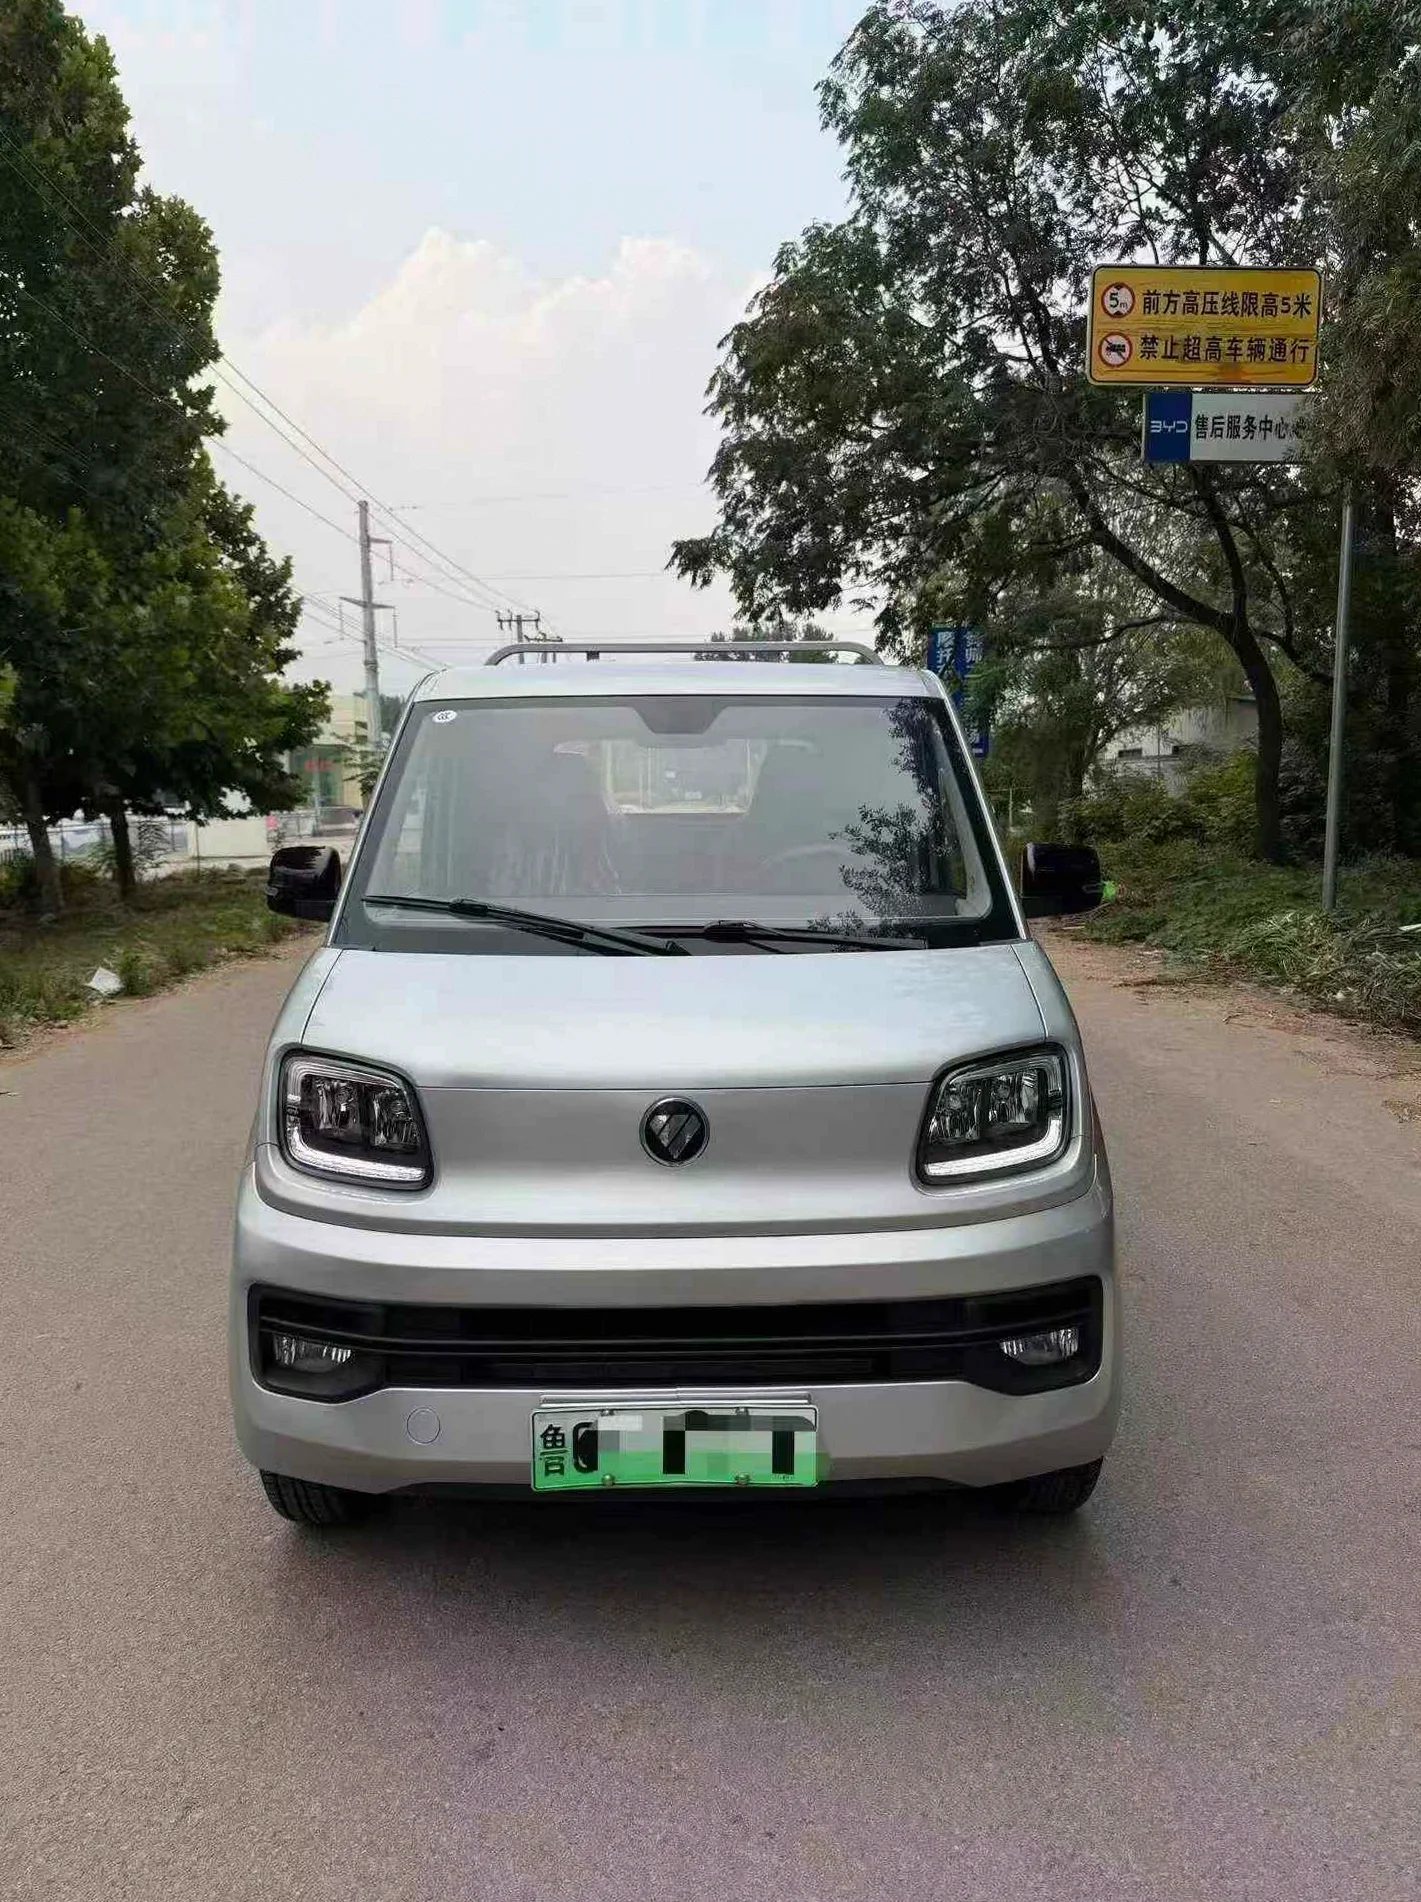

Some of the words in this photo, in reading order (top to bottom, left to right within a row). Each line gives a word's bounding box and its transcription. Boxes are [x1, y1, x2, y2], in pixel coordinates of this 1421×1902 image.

[1142, 289, 1312, 319] 前方高压线限高5米
[1140, 335, 1310, 363] 禁止超高车辆通行
[1151, 420, 1188, 433] BYD
